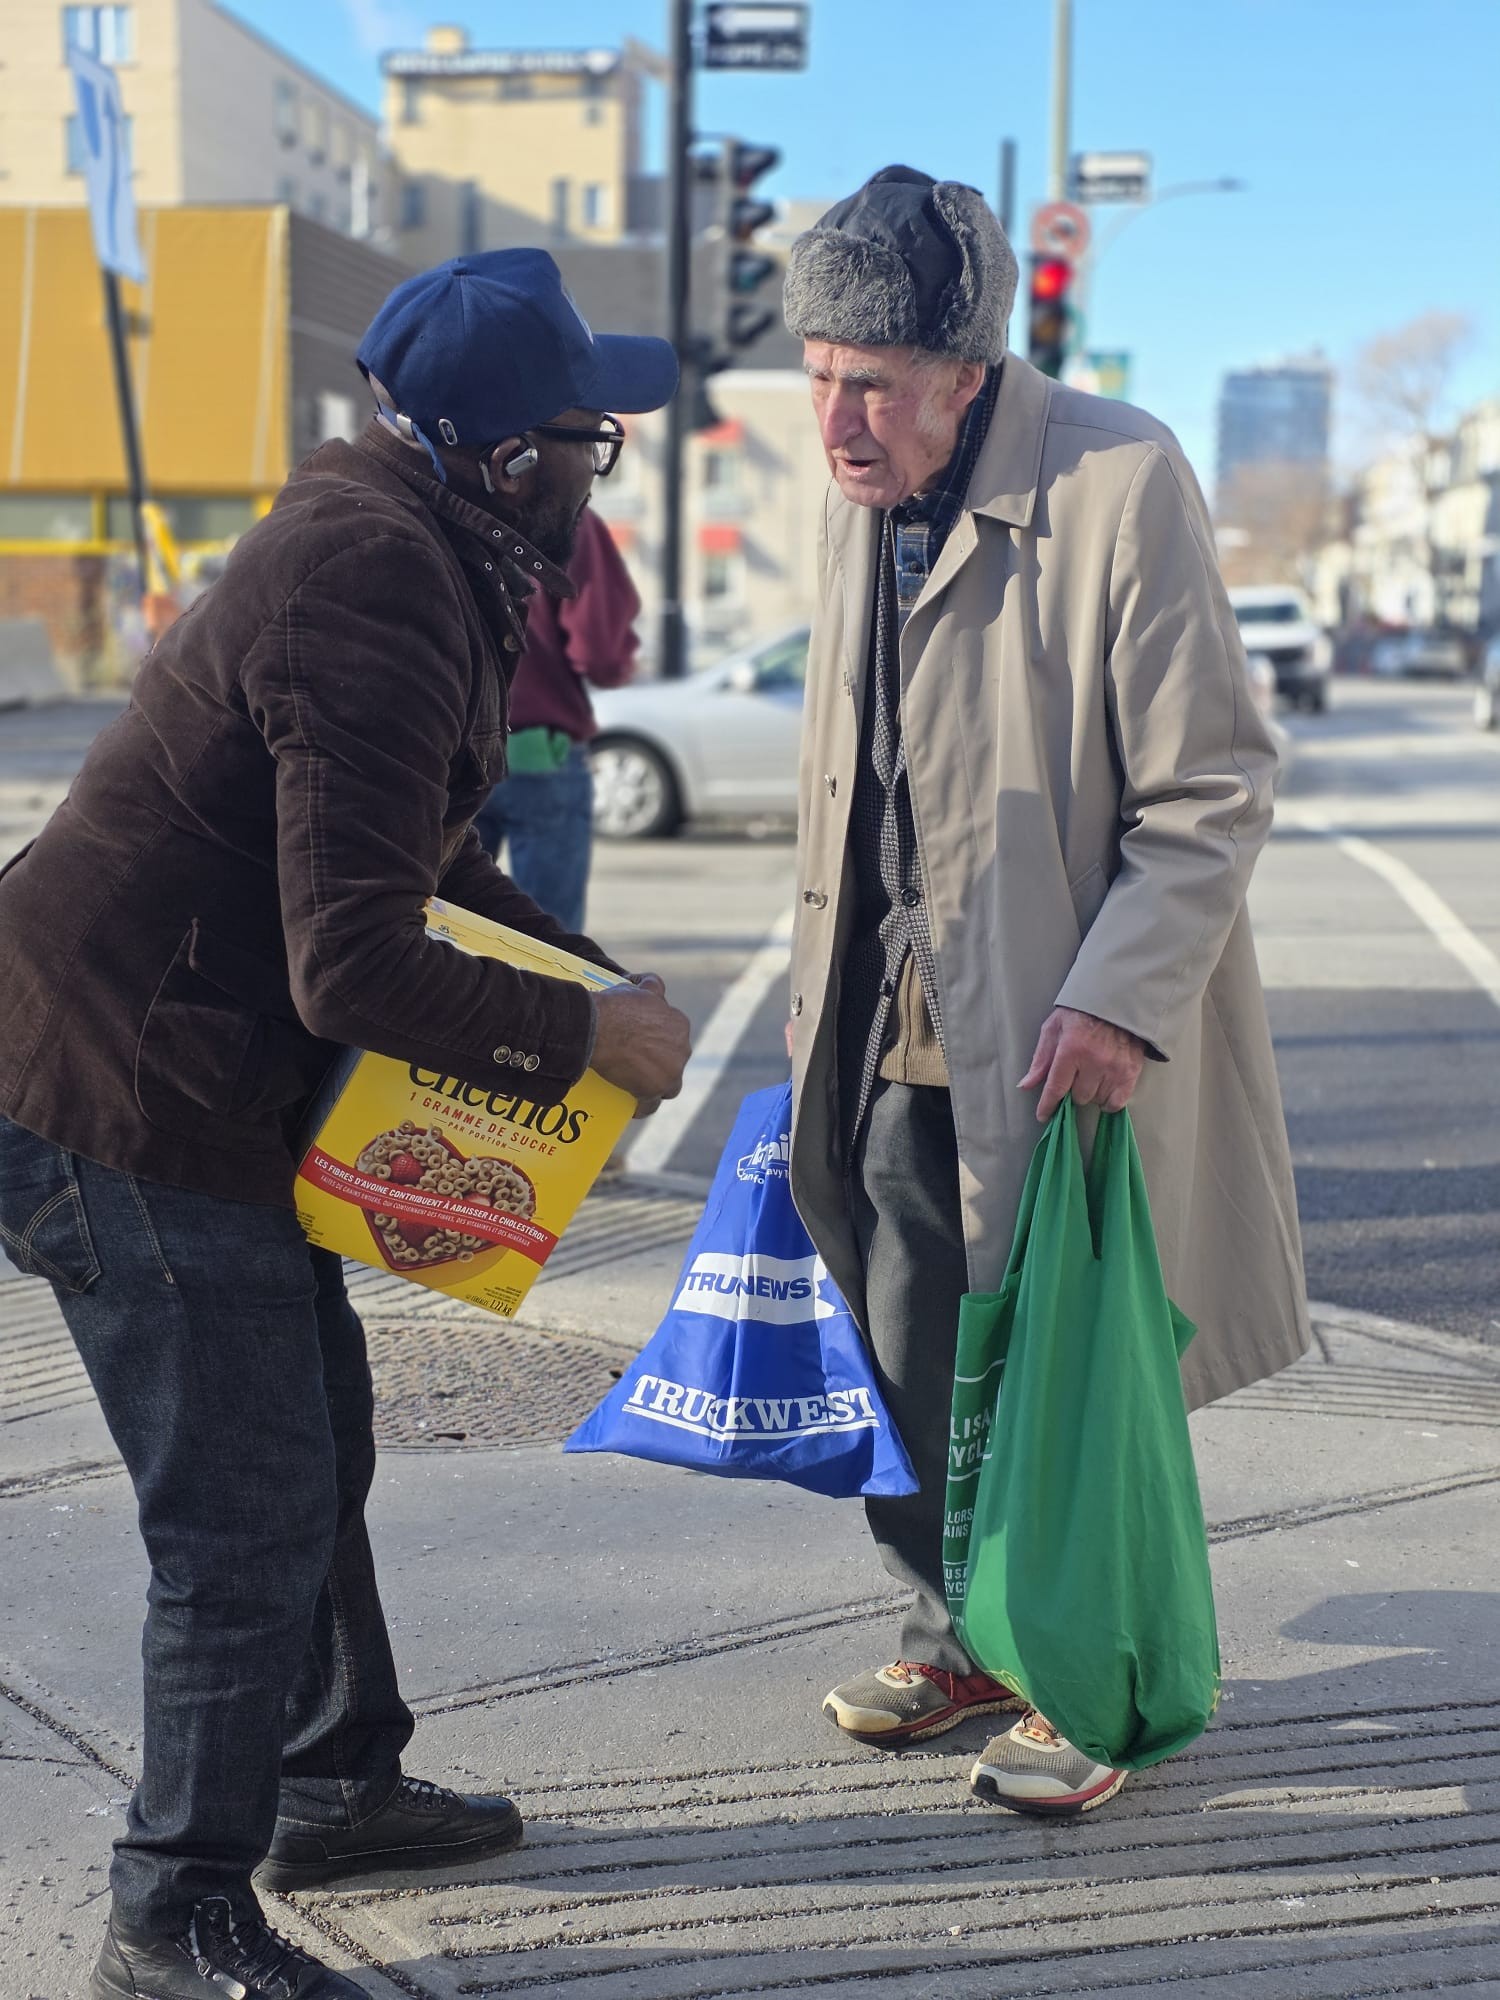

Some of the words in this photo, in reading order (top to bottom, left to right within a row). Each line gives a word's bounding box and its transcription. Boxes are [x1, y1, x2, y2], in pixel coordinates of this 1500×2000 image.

[410, 1091, 417, 1101] 1
[422, 1097, 484, 1129] GRAMME
[488, 1122, 507, 1138] DE
[511, 1132, 557, 1156] SUCRE
[448, 1121, 465, 1133] PAR
[469, 1129, 507, 1149] PORTION
[314, 1155, 328, 1169] LES
[328, 1164, 354, 1183] FIBRES
[354, 1177, 390, 1196] D'AVOINE
[389, 1189, 442, 1208] CONTRIBUENT
[443, 1200, 450, 1210] À
[450, 1204, 489, 1220] ABAISSER
[488, 1213, 499, 1223] LE
[628, 1374, 877, 1432] TRUCKWEST
